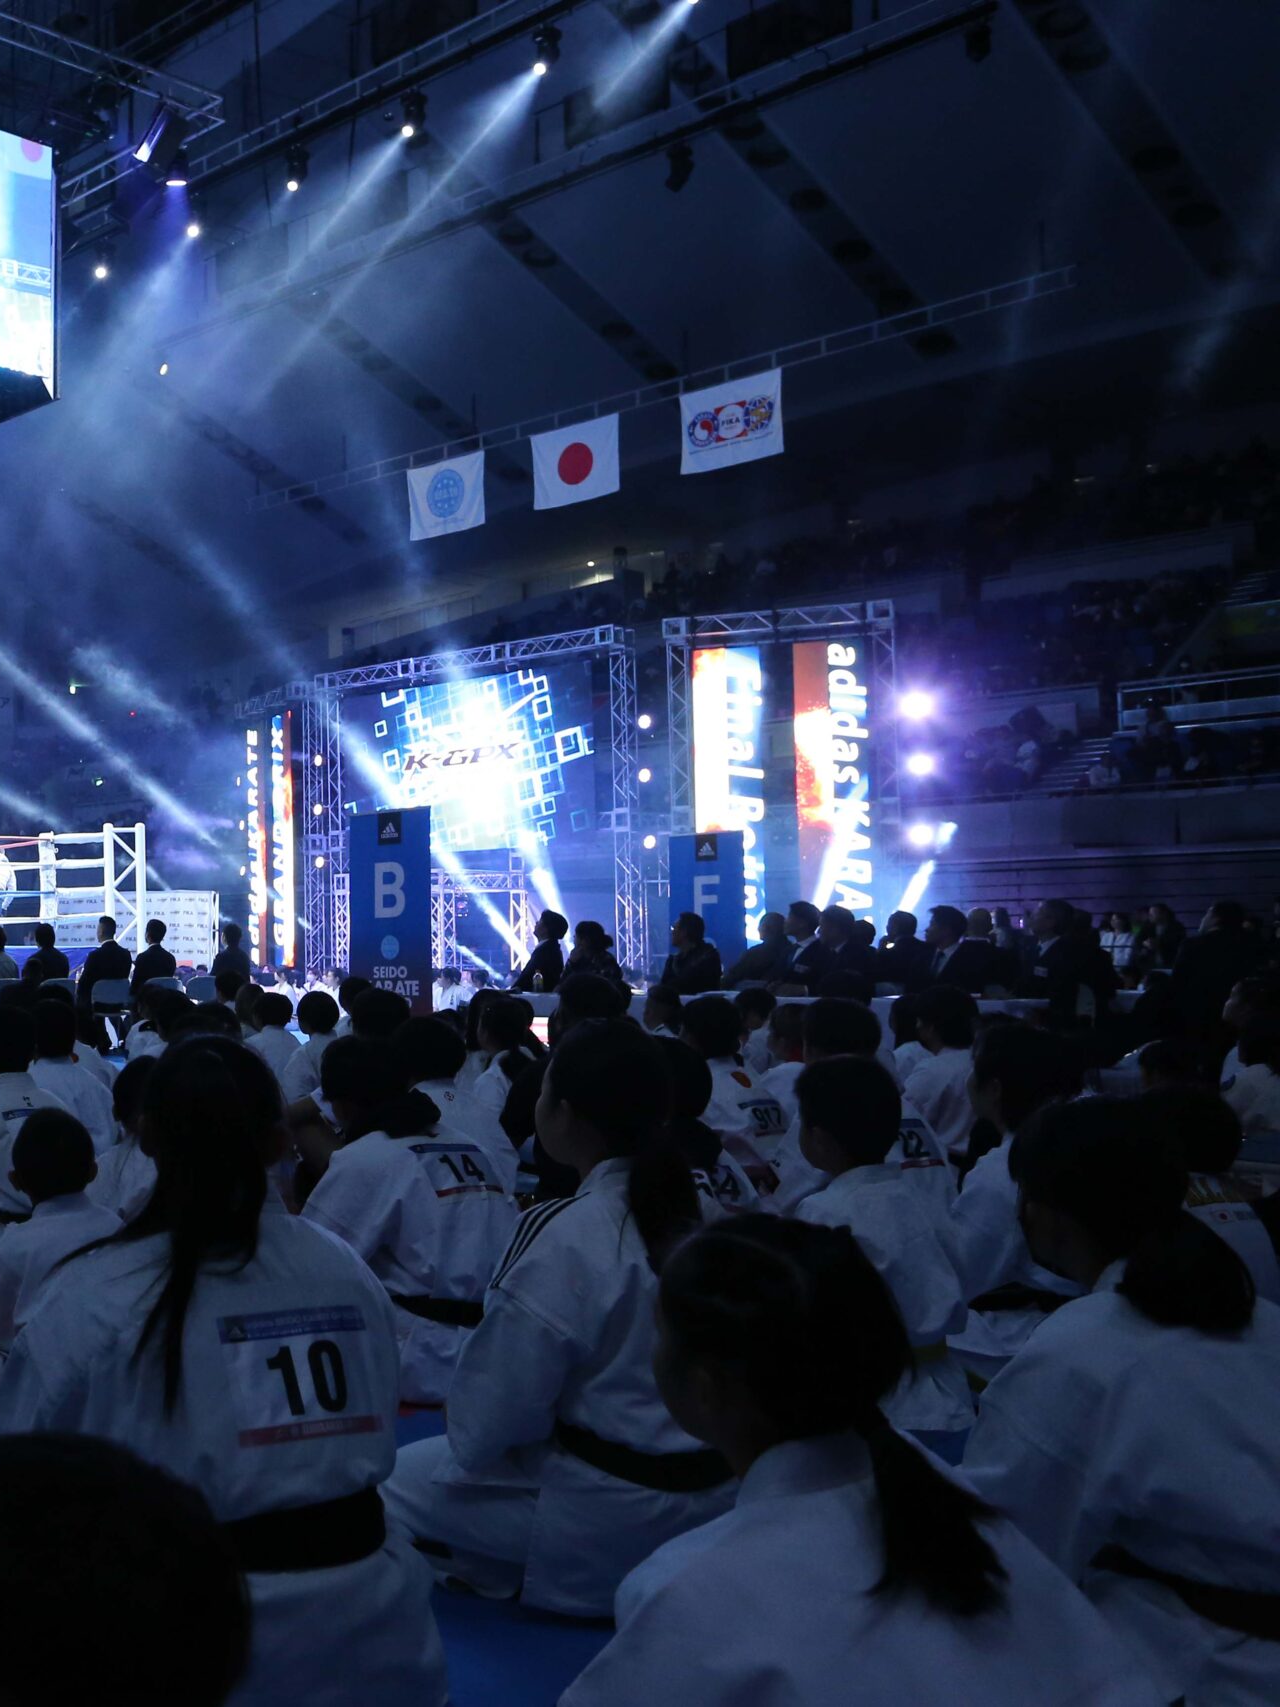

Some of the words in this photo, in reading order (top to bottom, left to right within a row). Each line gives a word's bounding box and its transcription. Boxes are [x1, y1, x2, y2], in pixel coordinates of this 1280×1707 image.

[725, 664, 765, 779] Final
[827, 643, 869, 785] adidas
[374, 861, 406, 919] B
[832, 799, 873, 925] KARA
[694, 875, 720, 918] F
[369, 980, 419, 997] ARATE
[373, 965, 408, 979] SEIDO
[439, 1153, 486, 1183] 14
[266, 1339, 347, 1416] 10
